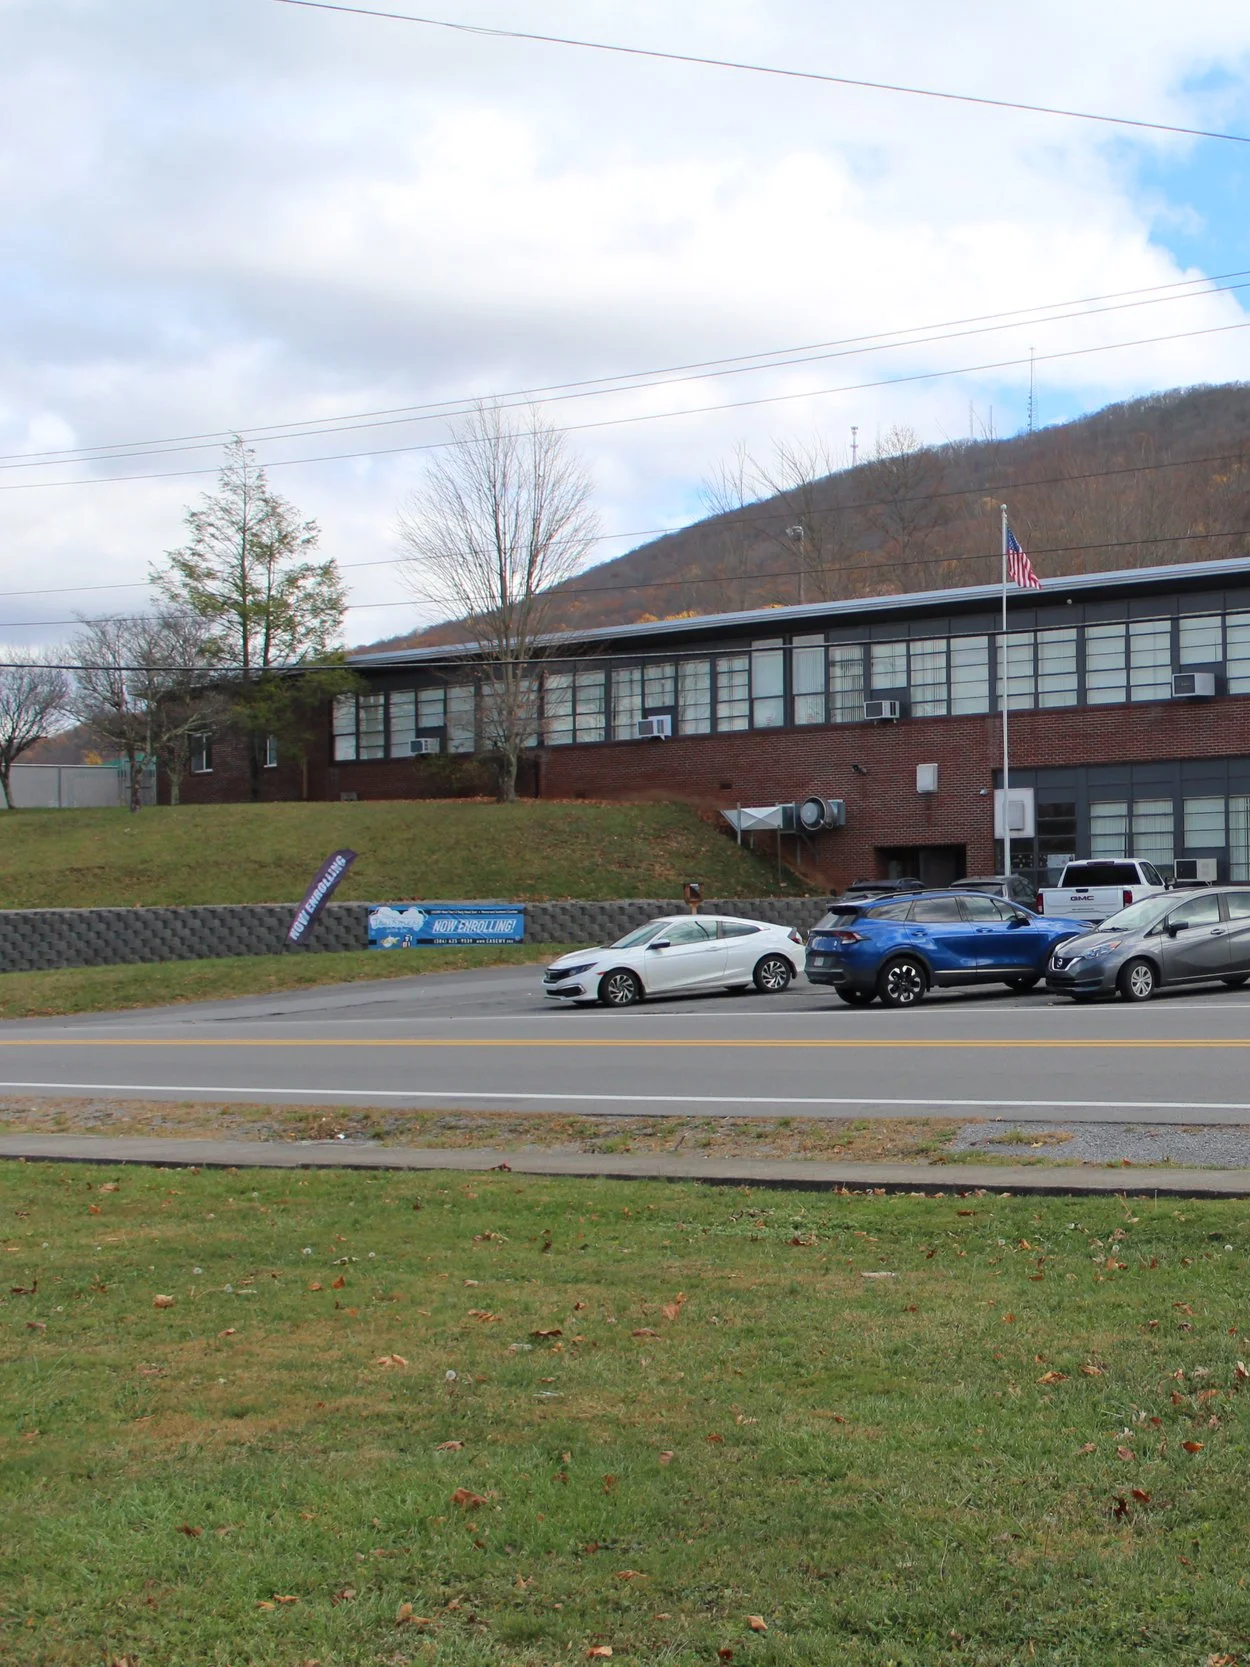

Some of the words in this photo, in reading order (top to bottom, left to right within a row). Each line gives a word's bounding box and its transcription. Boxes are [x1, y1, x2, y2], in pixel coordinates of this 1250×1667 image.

[289, 909, 310, 941] NOW
[305, 855, 347, 914] ENROLLING
[432, 919, 458, 934] NOW
[457, 919, 517, 934] ENROLLING!
